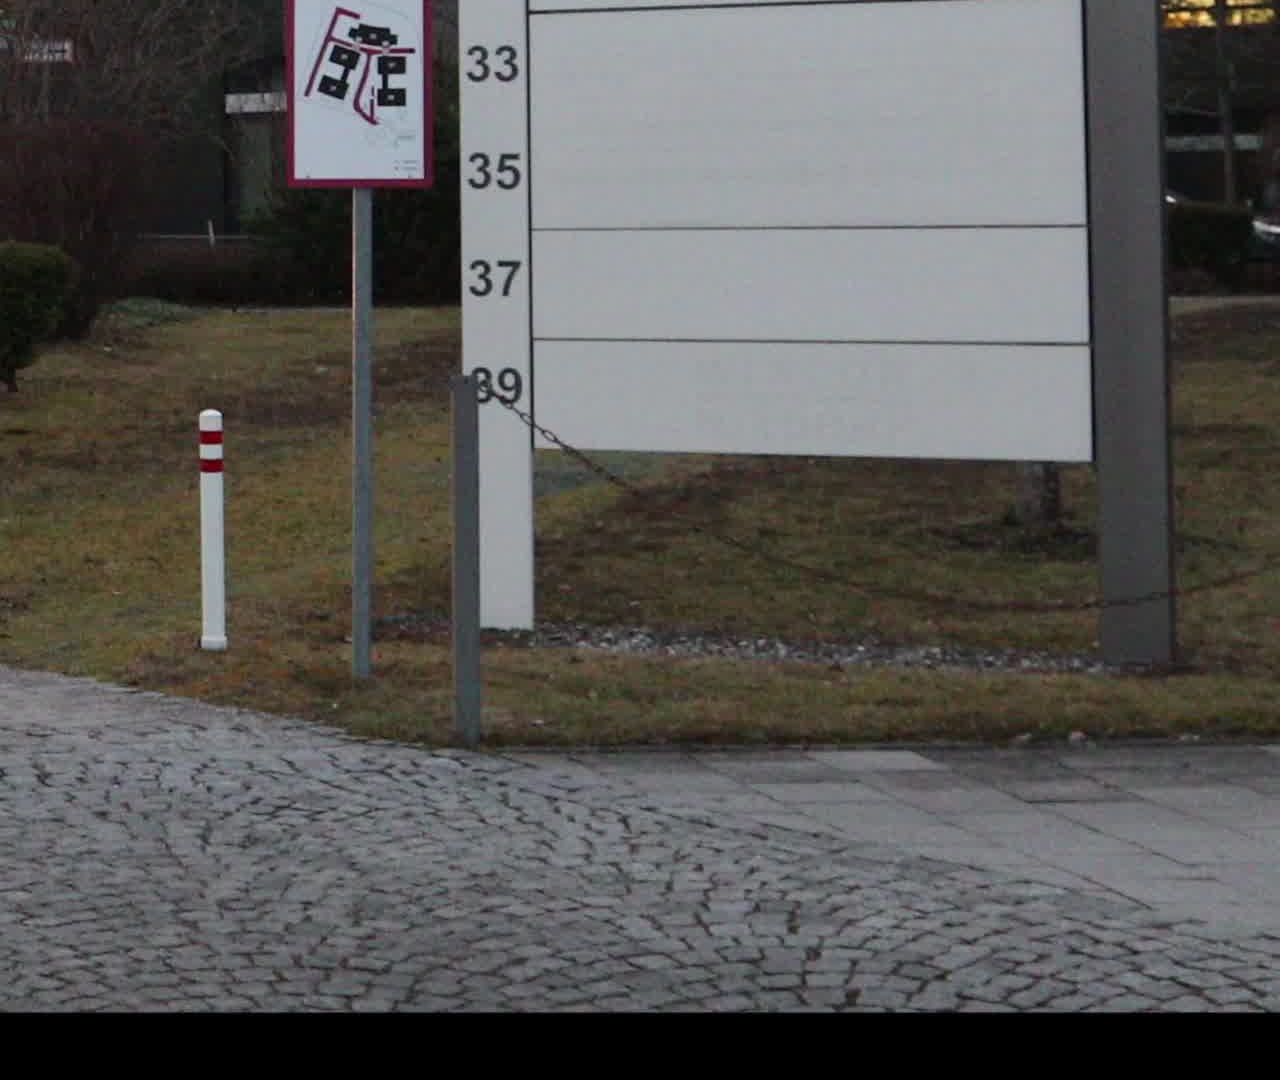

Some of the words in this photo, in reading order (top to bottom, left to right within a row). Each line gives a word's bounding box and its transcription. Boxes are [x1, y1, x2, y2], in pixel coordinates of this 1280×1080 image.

[466, 45, 519, 83] 33
[468, 152, 521, 190] 35
[469, 260, 521, 297] 37
[471, 367, 522, 405] 39
